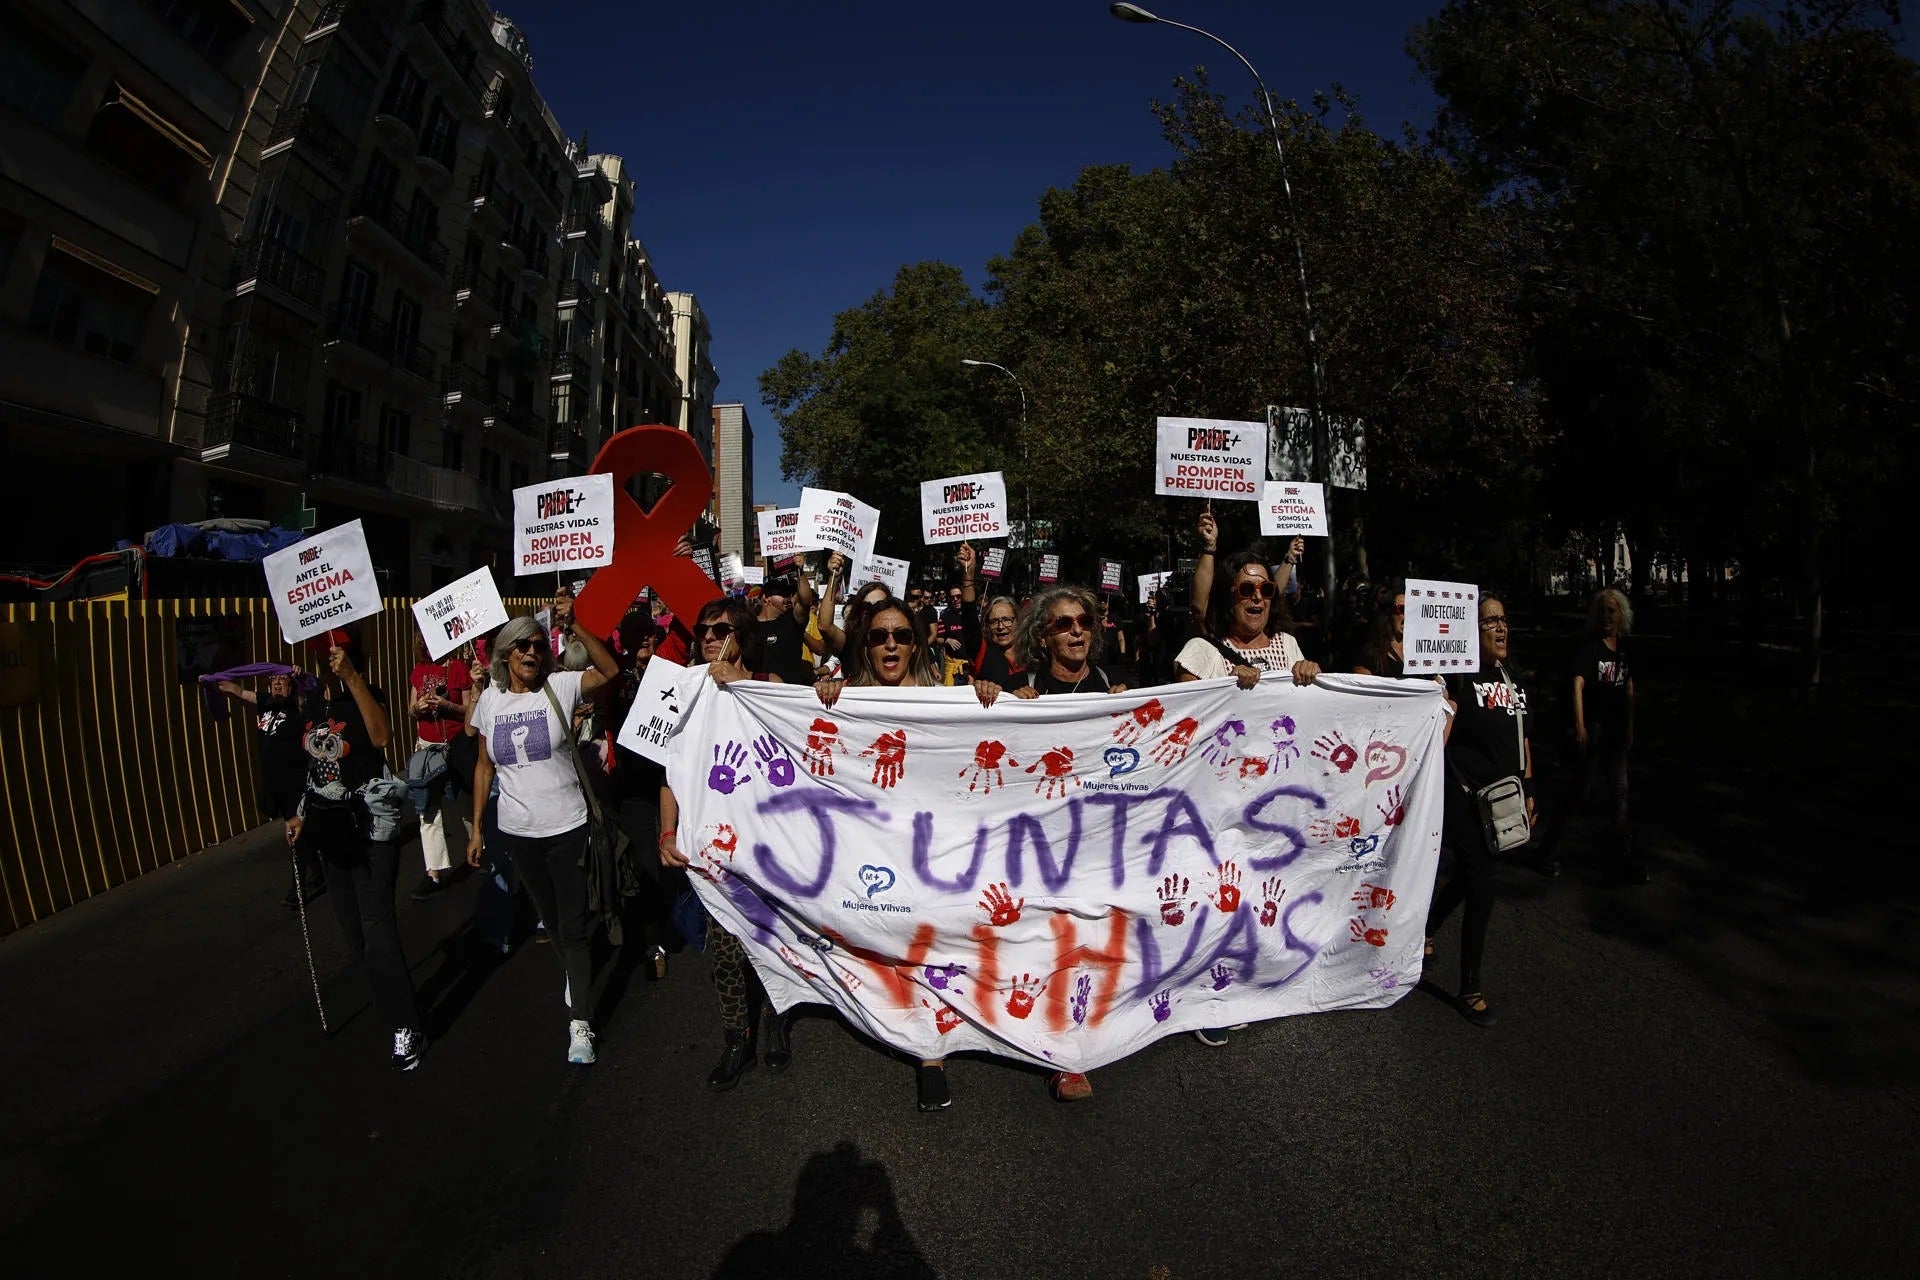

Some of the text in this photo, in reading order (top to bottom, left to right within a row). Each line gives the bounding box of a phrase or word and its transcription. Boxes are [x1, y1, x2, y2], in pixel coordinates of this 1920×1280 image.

[1170, 453, 1252, 465] NUESTRAS VIDAS
[1177, 465, 1244, 480] ROMPEN
[1165, 477, 1255, 493] PREJUICIOS
[827, 508, 856, 523] ANTE EL
[933, 502, 995, 515] NUESTRAS VIDAS
[1271, 505, 1316, 514] ESTIGMA
[525, 517, 599, 535] NUESTRAS VIDAS
[813, 514, 863, 539] ESTIGMA
[938, 512, 989, 527] ROMPEN
[767, 528, 796, 536] NUESTRAS
[820, 526, 856, 544] SOMOS LA
[930, 522, 1000, 538] PREJUICIOS
[531, 532, 592, 551] ROMPEN
[816, 534, 856, 553] RESPUESTA
[523, 545, 604, 567] PREJUICIOS
[295, 563, 333, 584] ANTE EL
[287, 568, 354, 605] ESTIGMA
[298, 590, 346, 614] SOMOS LA
[299, 602, 353, 629] RESPUESTA
[1421, 604, 1466, 620] INDETECTABLE
[1415, 639, 1467, 653] INTRANSMISIBLE
[648, 715, 664, 732] VIH
[1083, 781, 1149, 791] Mujeres Vihvas
[753, 786, 1327, 899] JUNTAS
[842, 900, 911, 913] Mujeres Vihvas
